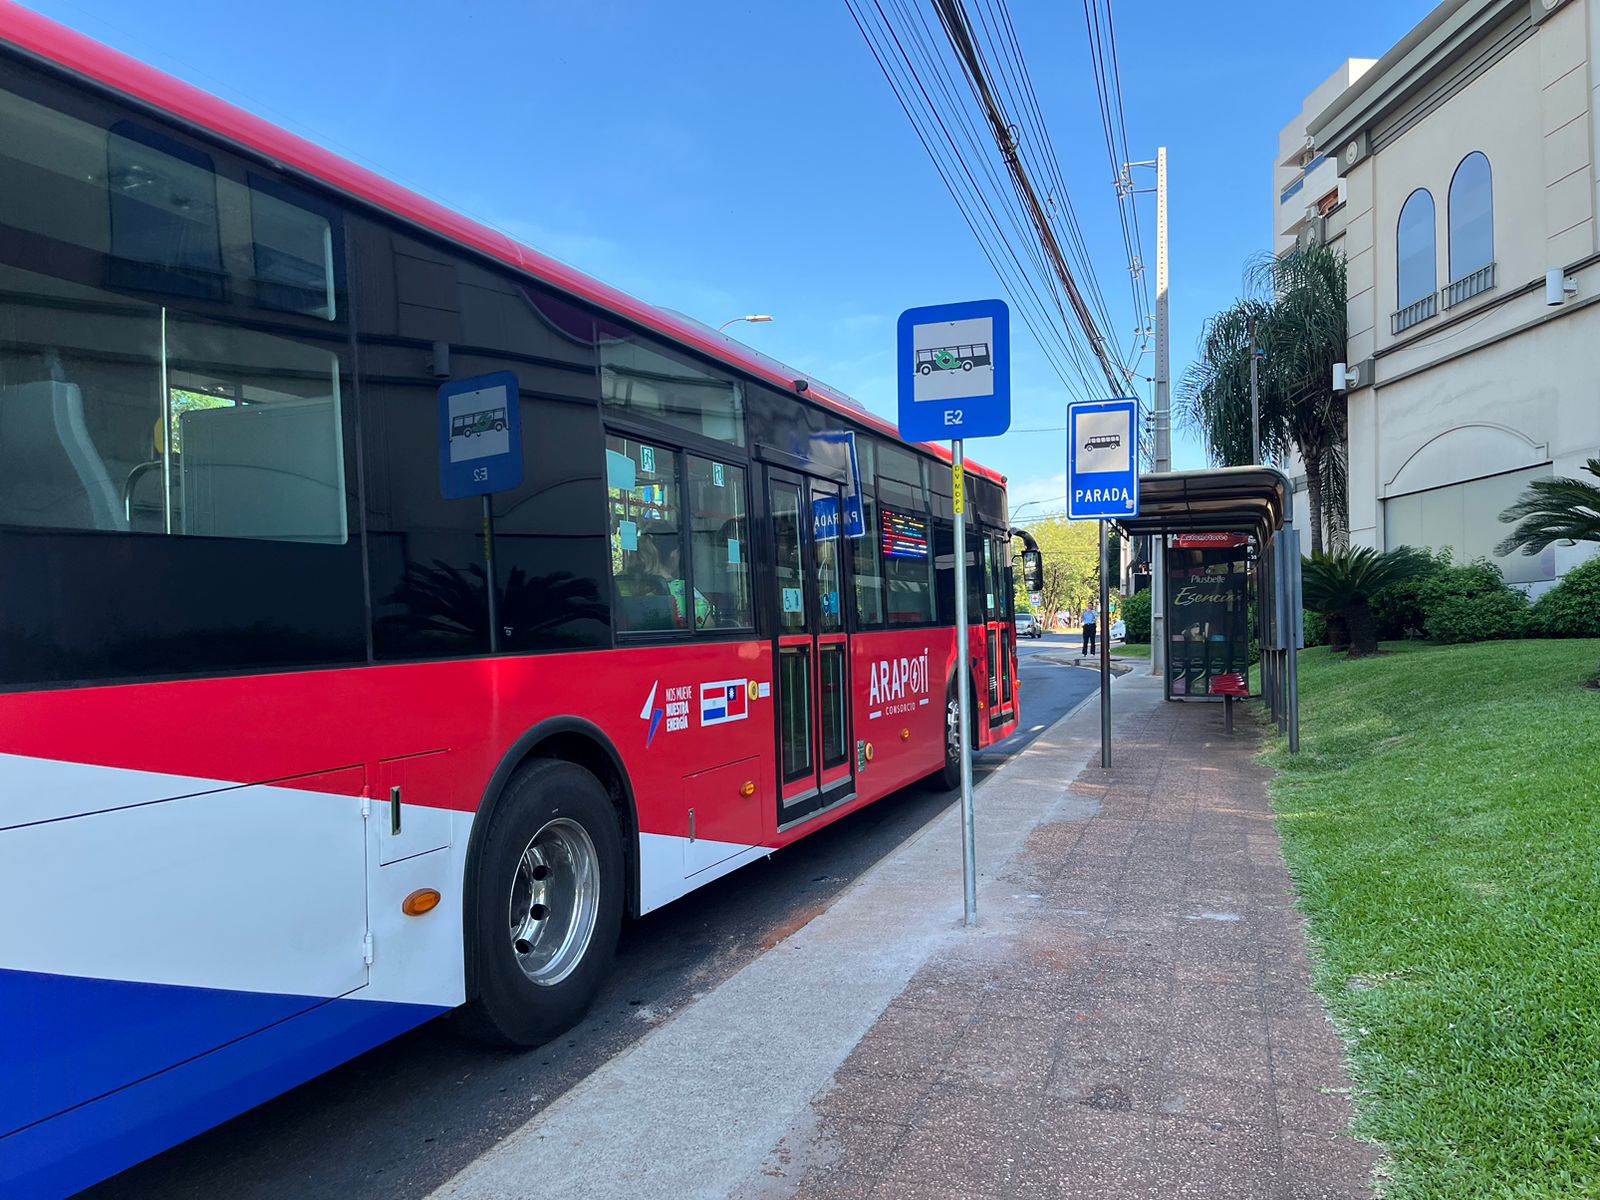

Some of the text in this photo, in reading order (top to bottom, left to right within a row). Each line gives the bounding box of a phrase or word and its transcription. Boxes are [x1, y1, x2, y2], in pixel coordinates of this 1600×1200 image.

[944, 409, 964, 425] E2
[1075, 487, 1129, 503] PARADA
[1190, 574, 1226, 583] Plusbelle
[869, 647, 929, 706] ARAPOTÍ
[665, 685, 692, 702] NOS MUEVE
[666, 701, 689, 717] NUESTRA
[885, 702, 916, 716] CONSORCIO
